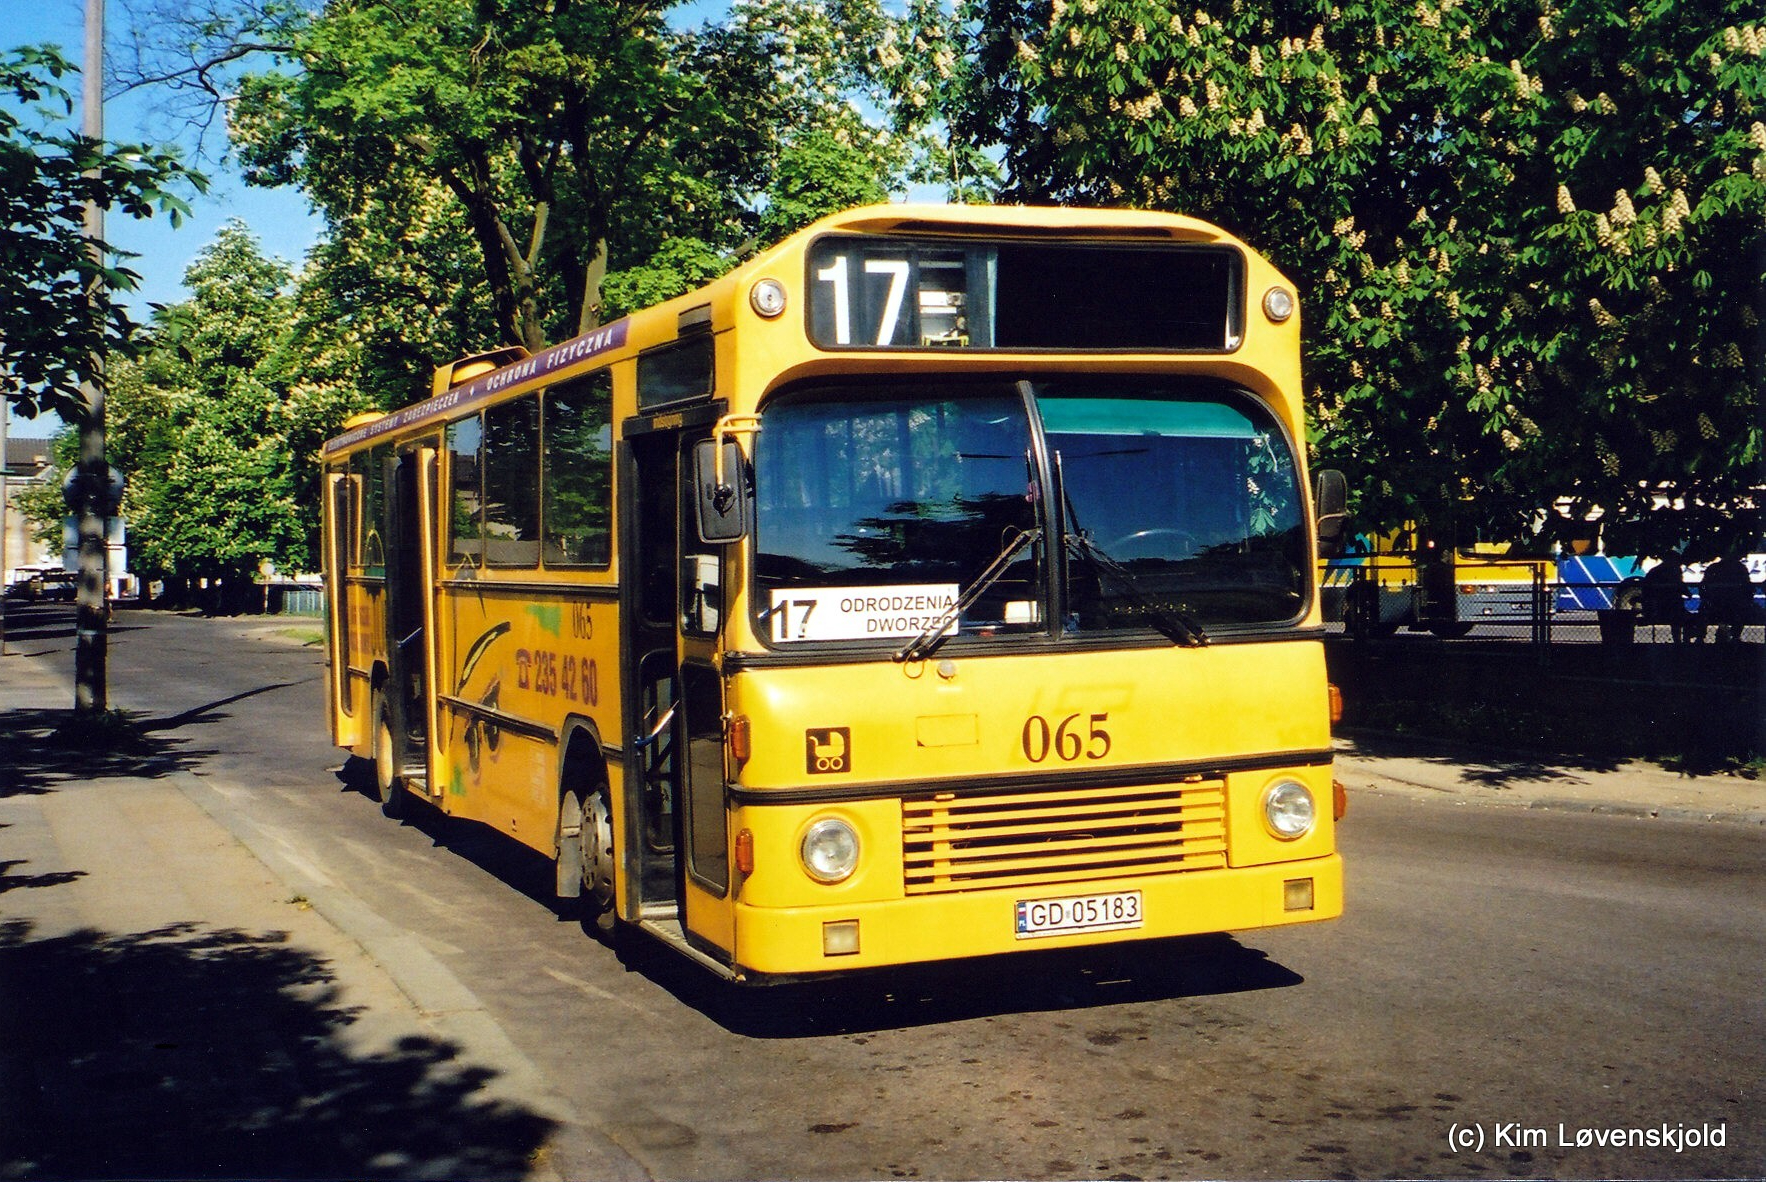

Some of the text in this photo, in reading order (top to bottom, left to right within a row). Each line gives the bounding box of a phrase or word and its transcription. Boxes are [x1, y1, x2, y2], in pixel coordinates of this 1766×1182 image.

[818, 256, 909, 345] 17
[486, 359, 536, 391] OCHRONA
[547, 328, 612, 369] FIZYCZNA
[573, 601, 592, 639] 065
[772, 600, 817, 639] 17
[840, 595, 953, 613] ODRODZENIA
[534, 650, 598, 707] 235 42 60
[1022, 712, 1111, 763] 065
[1031, 895, 1138, 926] GD 05183
